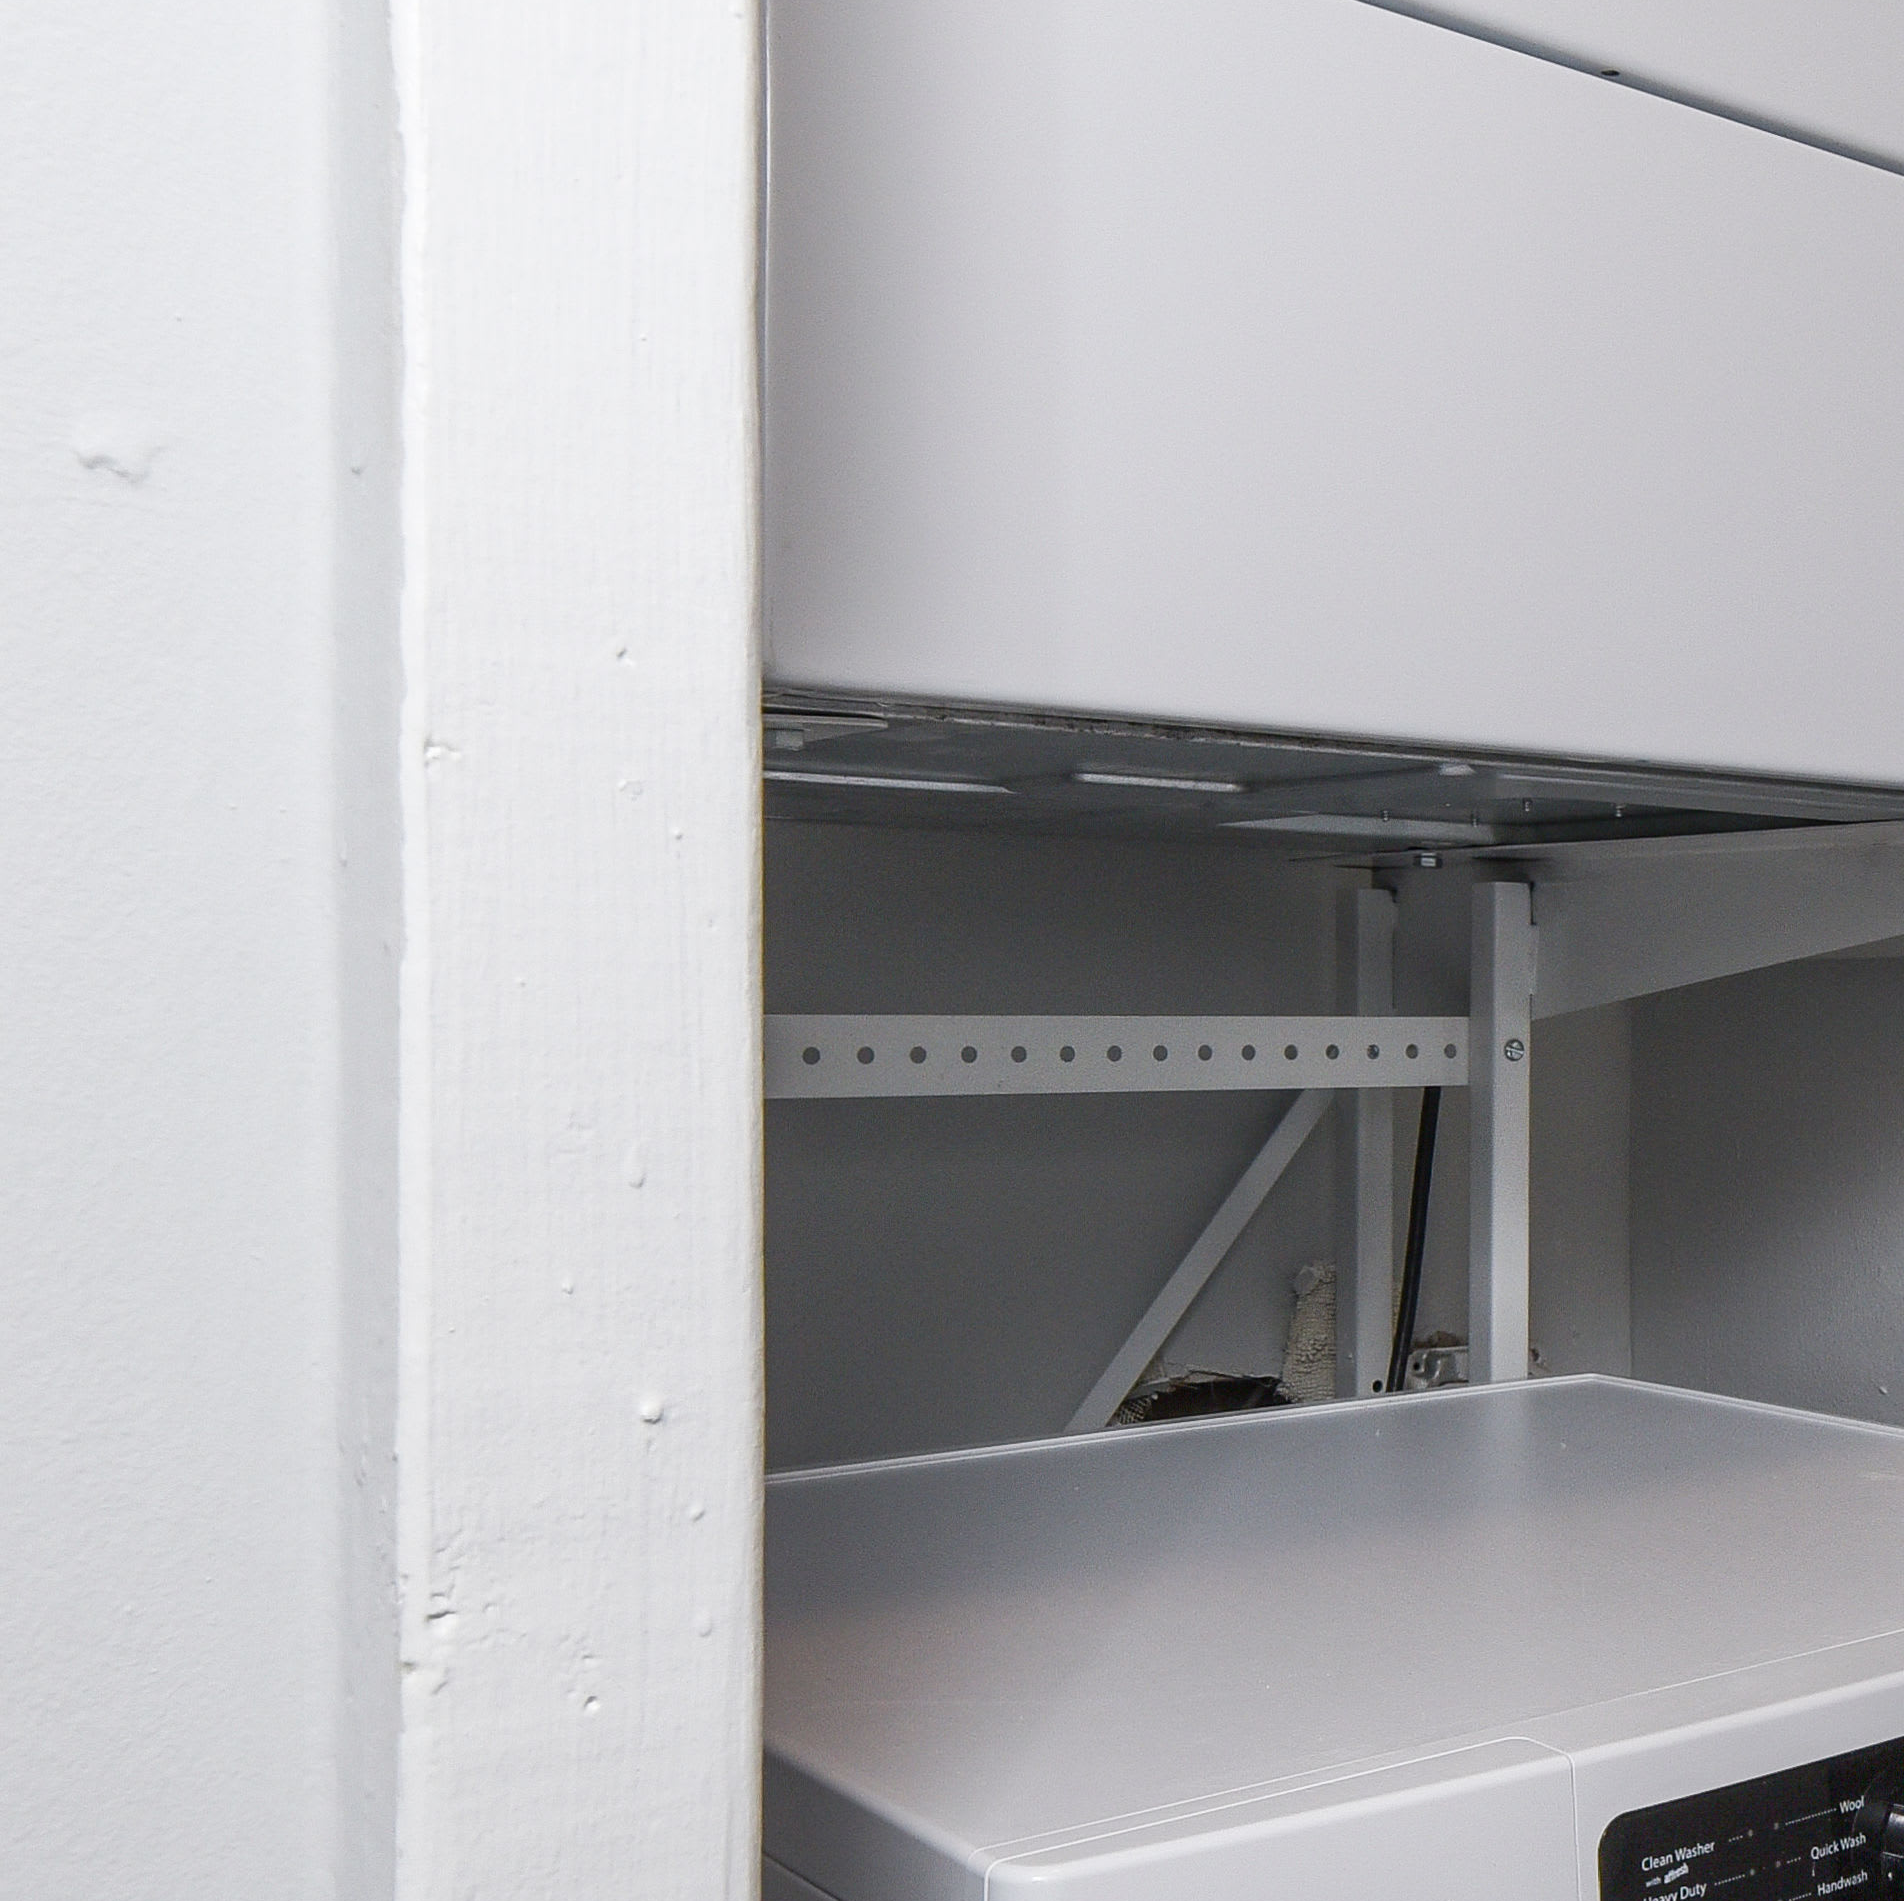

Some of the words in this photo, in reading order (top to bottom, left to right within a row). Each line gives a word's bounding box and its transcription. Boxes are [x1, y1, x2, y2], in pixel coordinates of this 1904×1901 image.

[1839, 1795, 1865, 1814] Wool
[1641, 1851, 1673, 1872] Clean
[1674, 1841, 1715, 1861] Washer
[1810, 1843, 1839, 1861] Quick
[1840, 1833, 1866, 1852] Wash
[1646, 1876, 1661, 1887] with
[1680, 1882, 1707, 1900] Duty
[1817, 1870, 1868, 1896] Handwash
